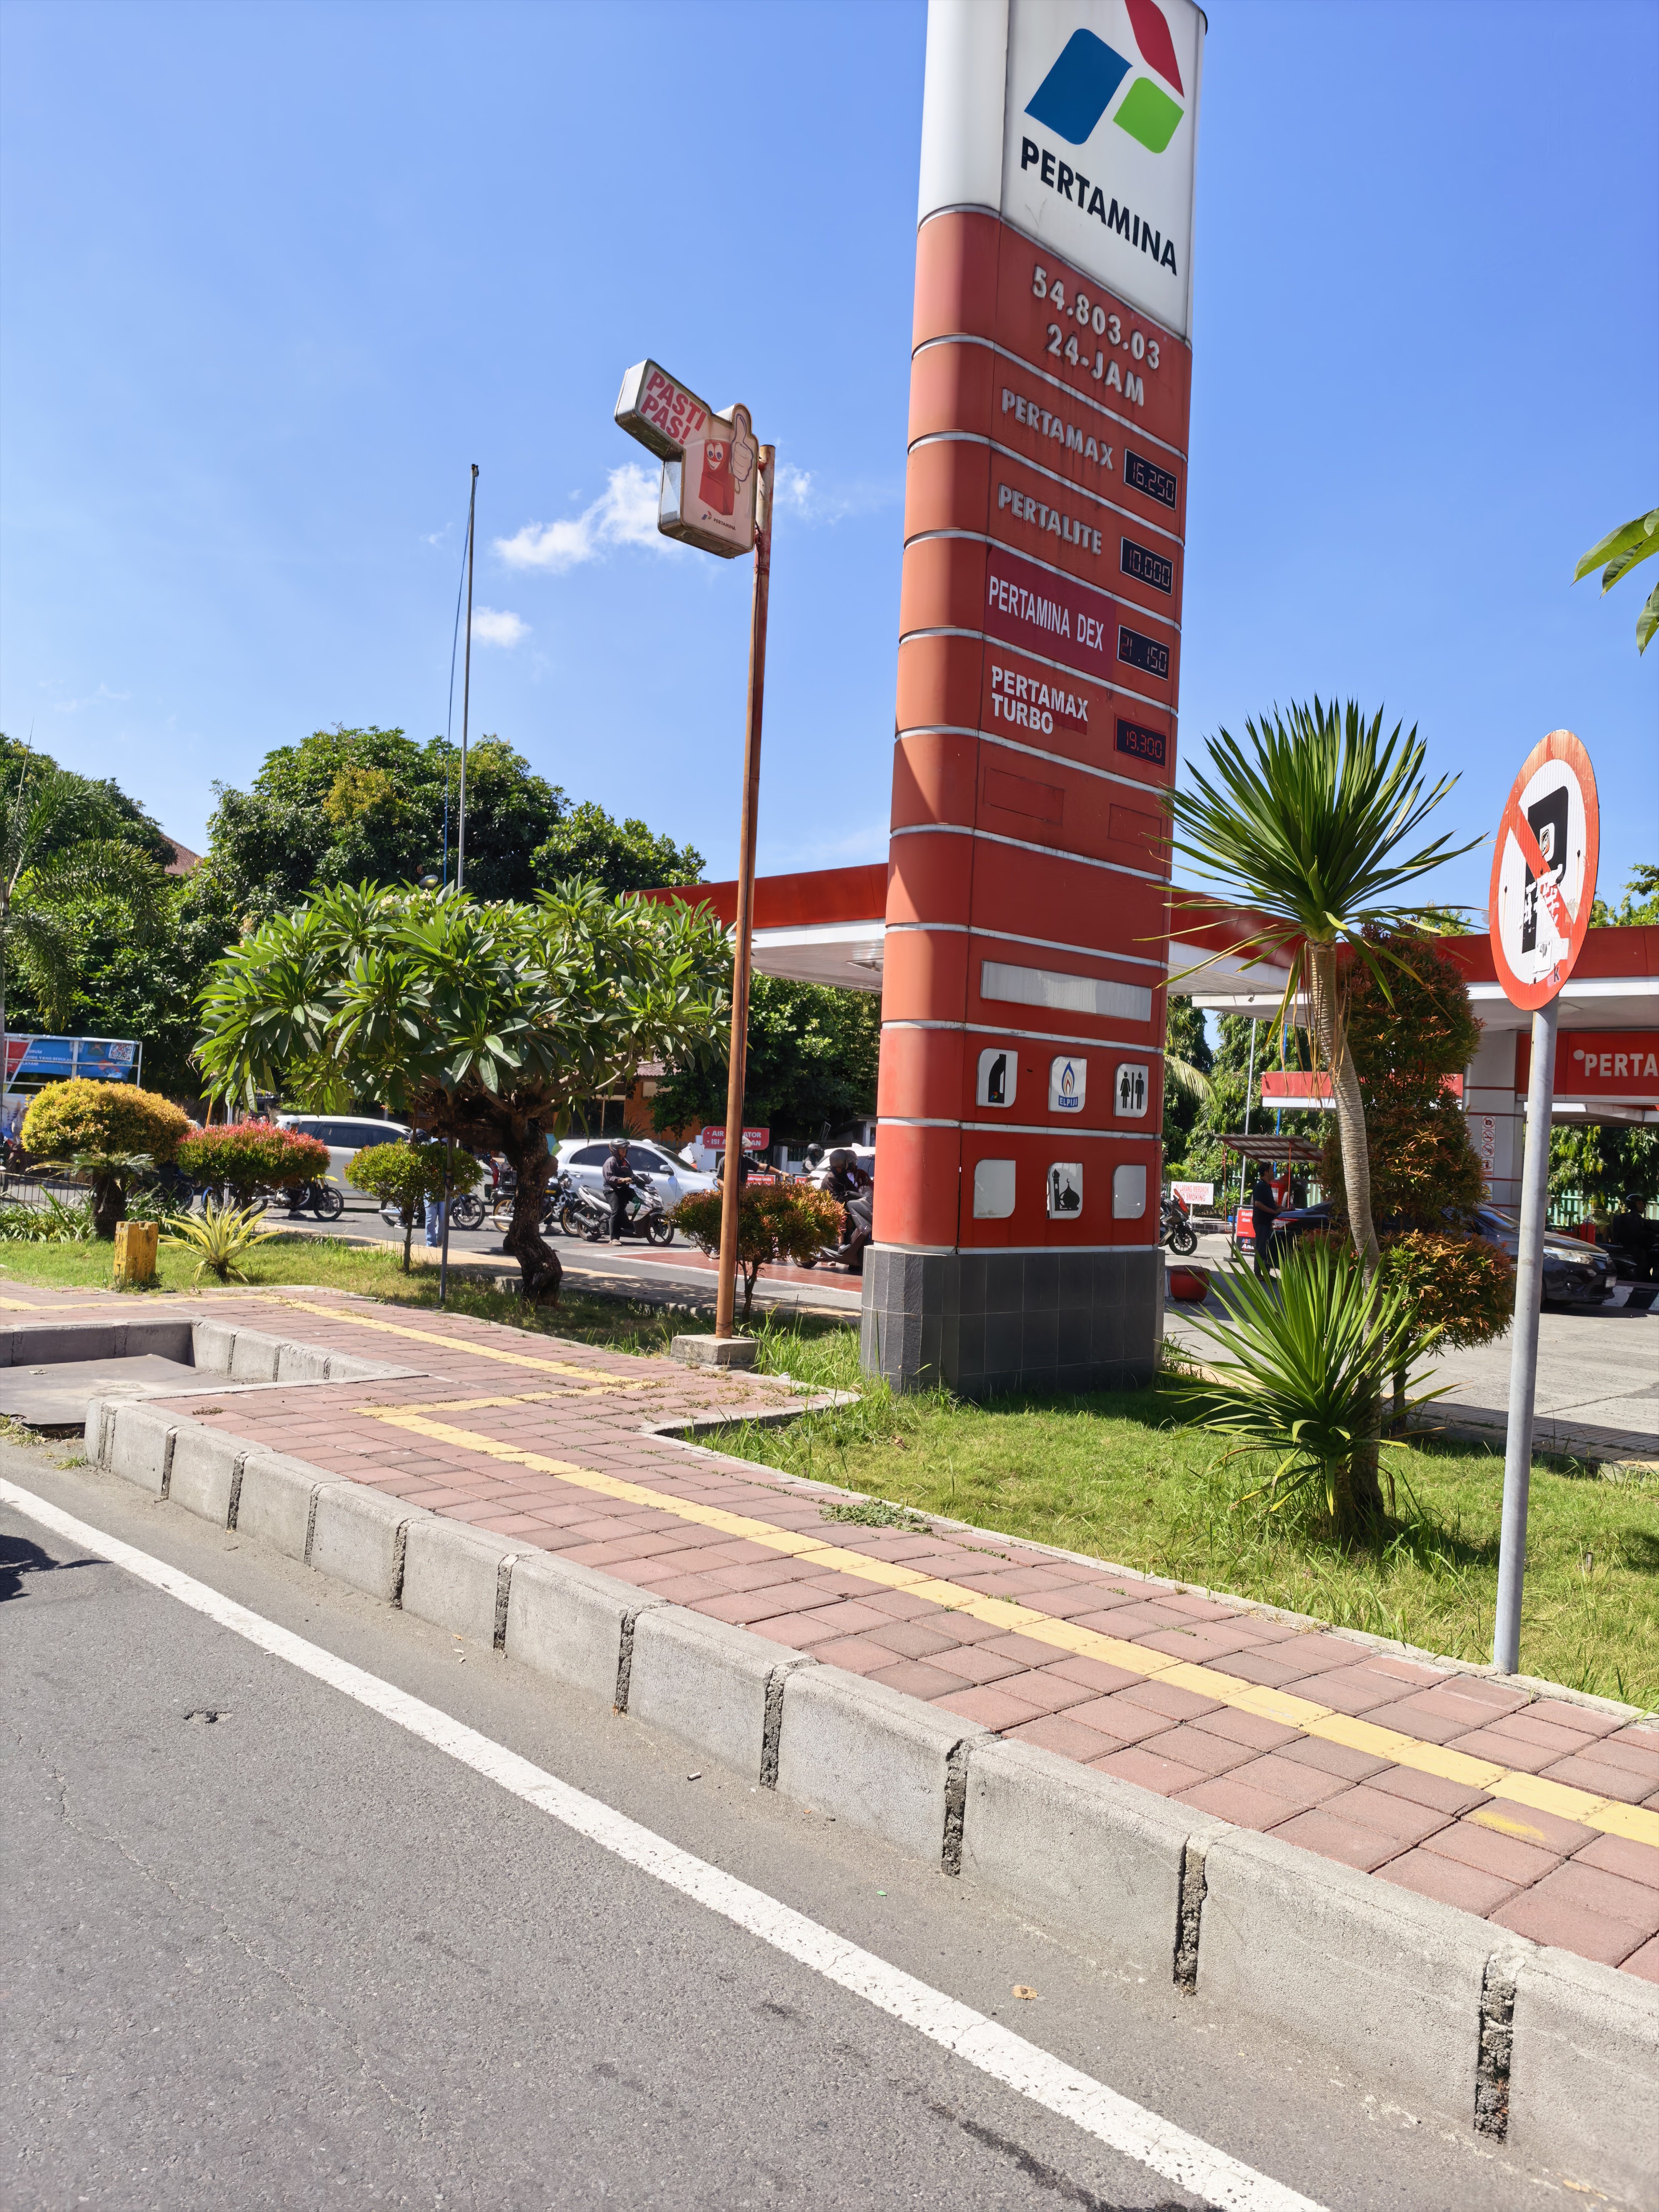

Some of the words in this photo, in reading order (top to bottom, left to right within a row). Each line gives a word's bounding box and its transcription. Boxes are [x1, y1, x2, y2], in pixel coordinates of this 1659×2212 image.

[1021, 136, 1177, 276] PERTAMINA
[1032, 265, 1160, 369] 54.803.03
[640, 394, 691, 445] PAS!
[646, 370, 708, 431] PASTI
[1002, 388, 1113, 470] PERTAMAX
[1133, 461, 1174, 502] 16.250
[998, 483, 1102, 555] PERTALITE
[1129, 548, 1170, 587] 10.000
[988, 575, 1070, 638] PERTAMINA
[1077, 613, 1104, 651] DEX
[992, 665, 1088, 722] PERTAMAX
[992, 692, 1053, 734] TURBO
[1126, 730, 1162, 759] 19.300
[1585, 1053, 1659, 1076] PERTA
[1060, 1097, 1077, 1106] ELPIJI
[1186, 1194, 1206, 1202] SMOKING
[1193, 1185, 1209, 1194] MEROKOK
